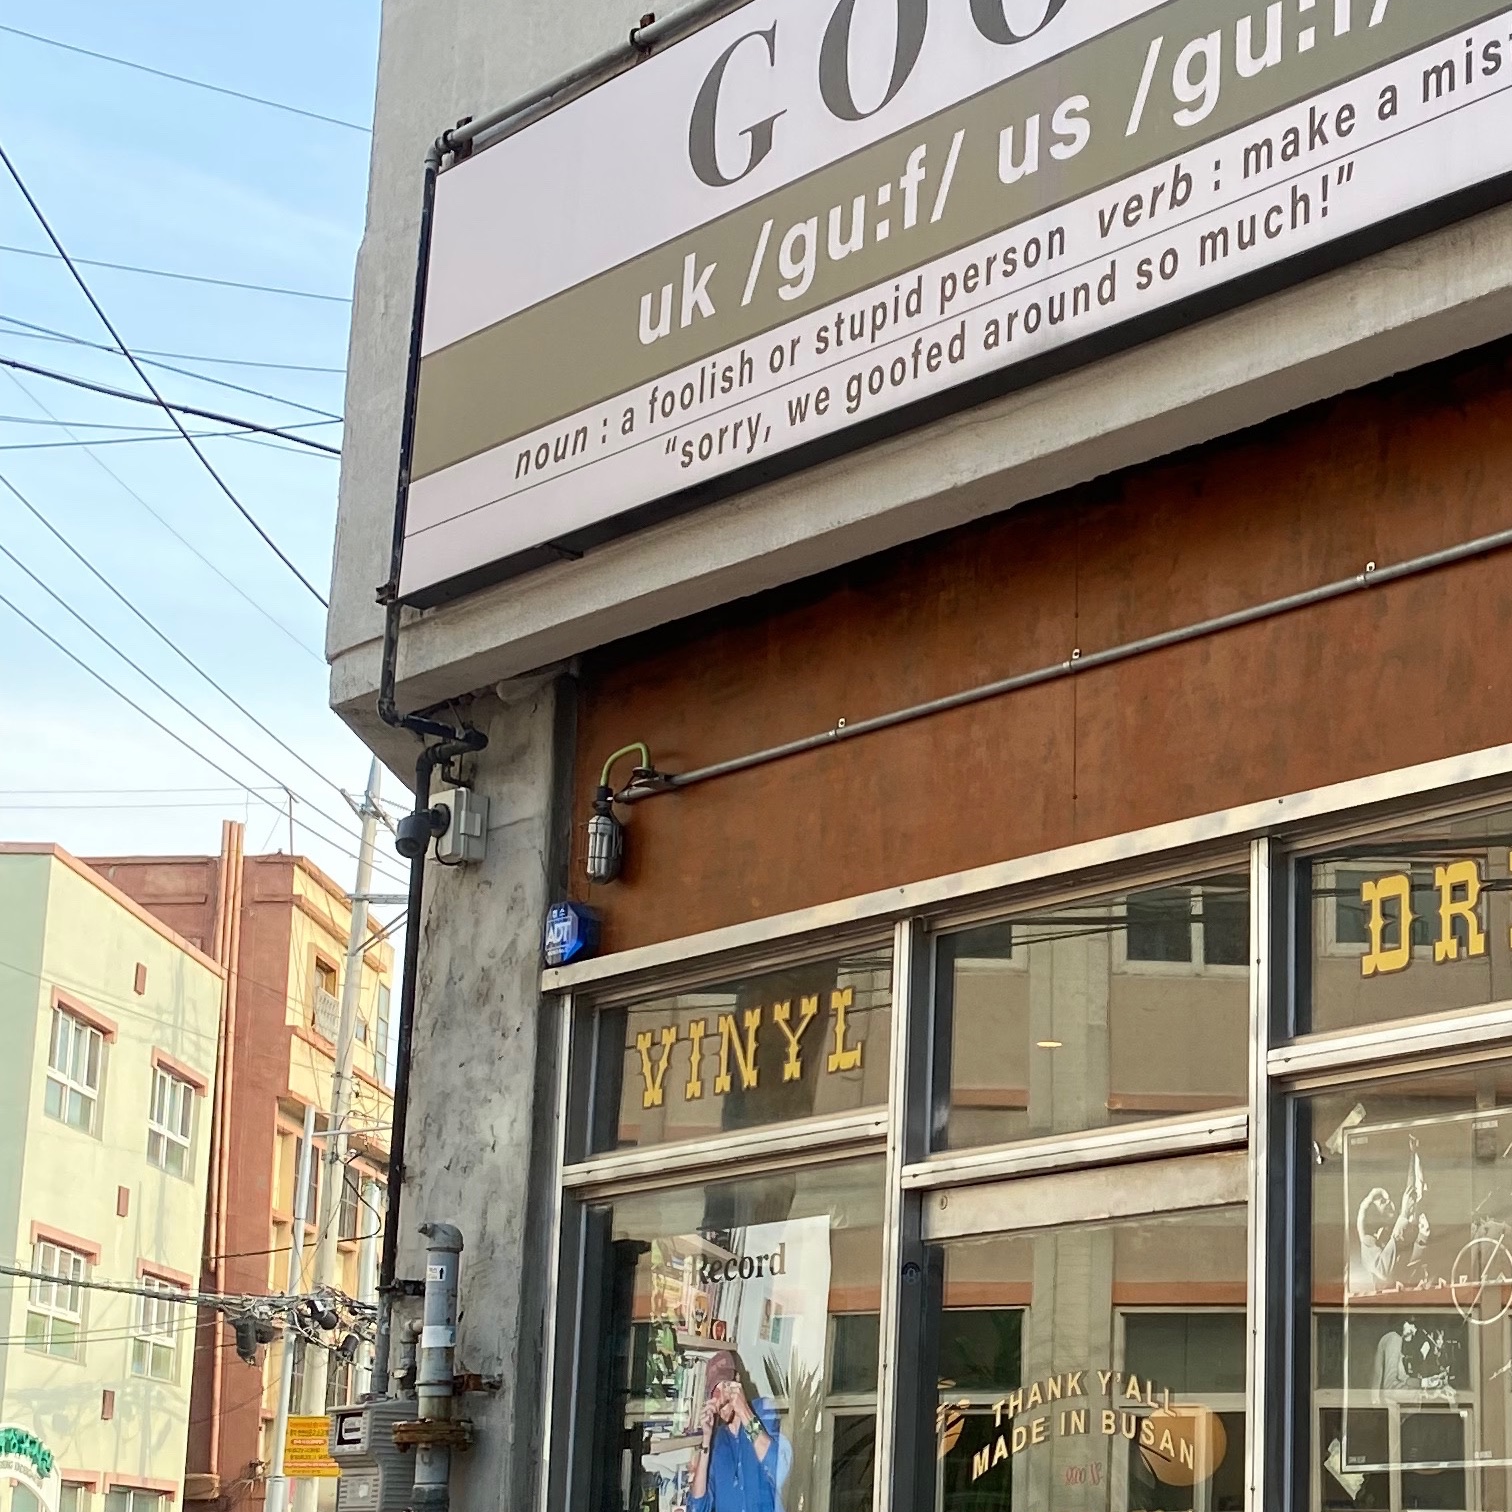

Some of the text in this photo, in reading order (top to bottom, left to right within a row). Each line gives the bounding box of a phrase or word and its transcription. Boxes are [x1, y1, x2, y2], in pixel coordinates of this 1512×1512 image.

[688, 0, 1067, 187] GO
[637, 0, 1389, 345] uk /gu:f/ us /gu:
[514, 425, 589, 479] noun
[621, 407, 635, 436] a
[649, 350, 753, 424] foolish
[769, 336, 801, 374] or
[815, 274, 923, 355] stupid
[940, 226, 1066, 316] person
[1098, 163, 1193, 239] verb
[1243, 103, 1356, 180] make
[1378, 84, 1398, 121] a
[788, 386, 830, 427] we
[846, 320, 966, 414] goofed
[983, 260, 1117, 350] around
[1136, 248, 1179, 291] so
[546, 921, 572, 946] ADT
[635, 987, 863, 1109] VINYL
[691, 1242, 786, 1286] Record
[971, 1416, 1048, 1484] MADE
[1059, 1409, 1087, 1436] IN
[1101, 1409, 1195, 1471] BUSAN
[991, 1369, 1178, 1428] THANK Y'ALL
